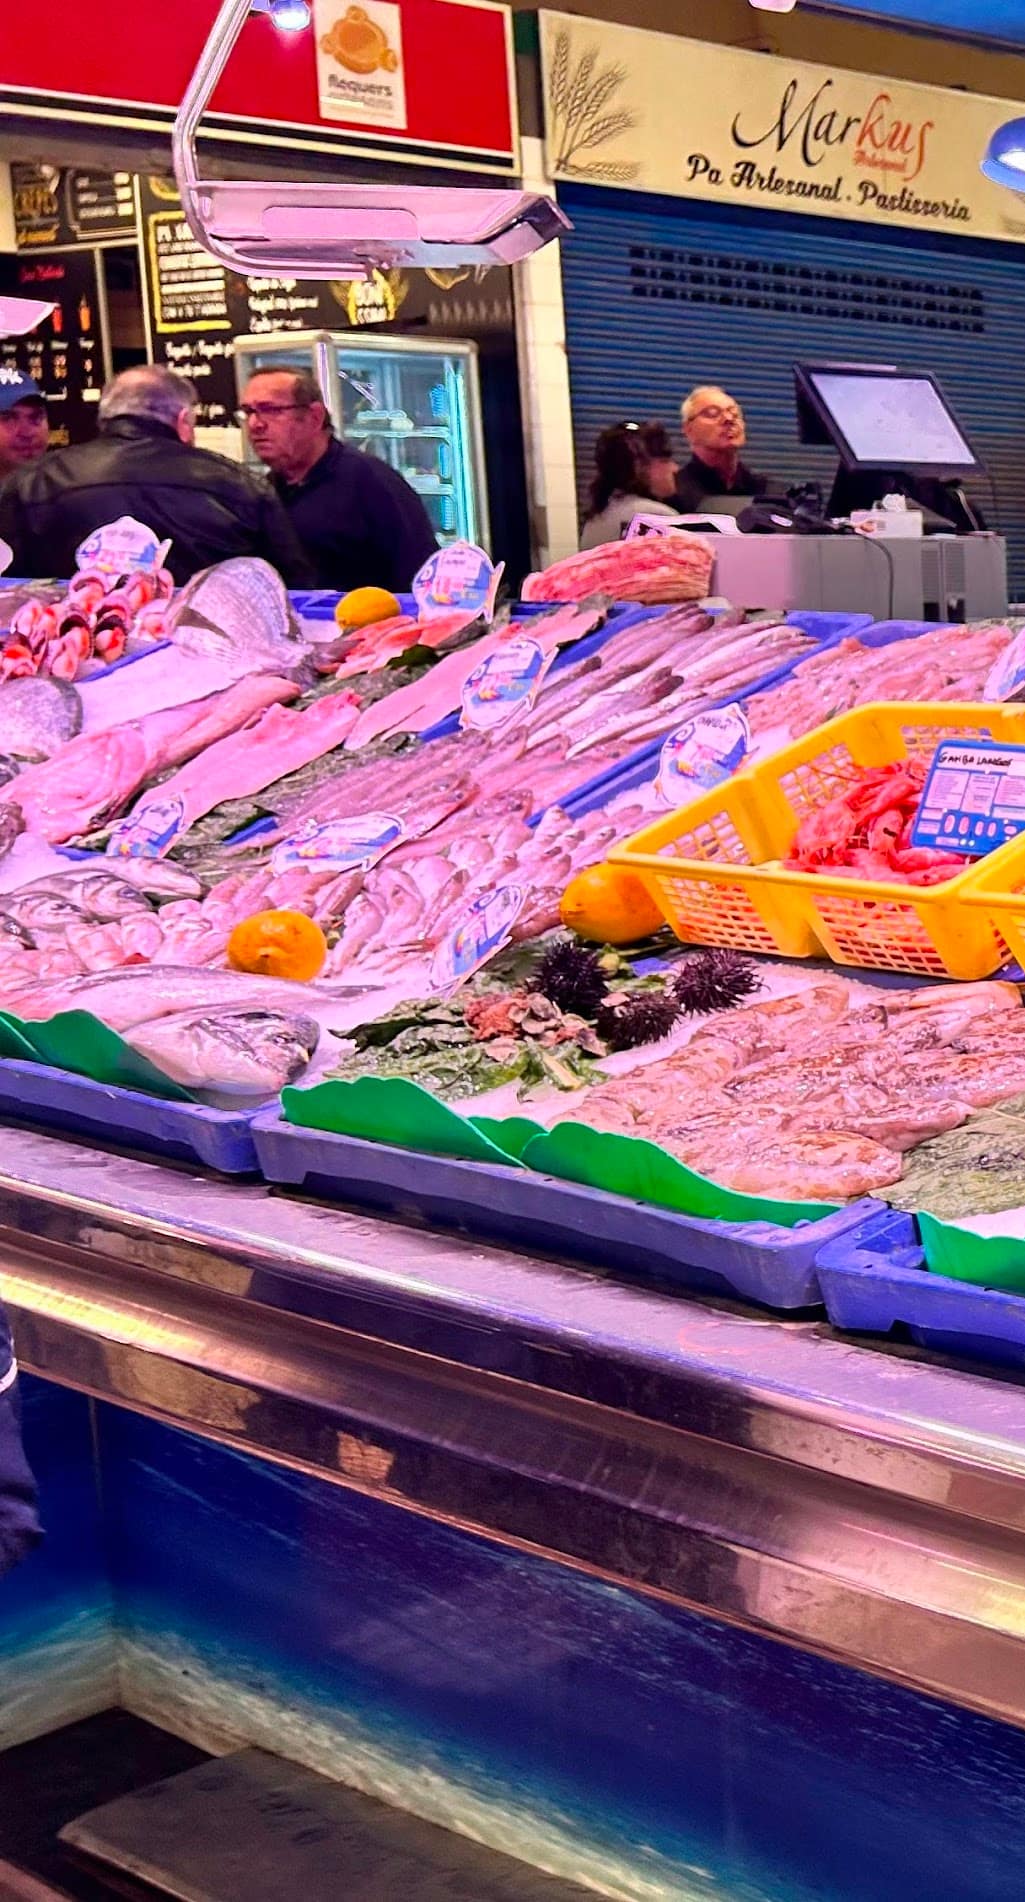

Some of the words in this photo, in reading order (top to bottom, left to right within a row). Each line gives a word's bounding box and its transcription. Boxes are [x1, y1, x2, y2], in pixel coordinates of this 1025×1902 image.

[731, 78, 934, 181] Markus
[687, 153, 723, 186] Pa
[730, 160, 842, 202] Artesanal
[857, 179, 971, 221] Pastisseria
